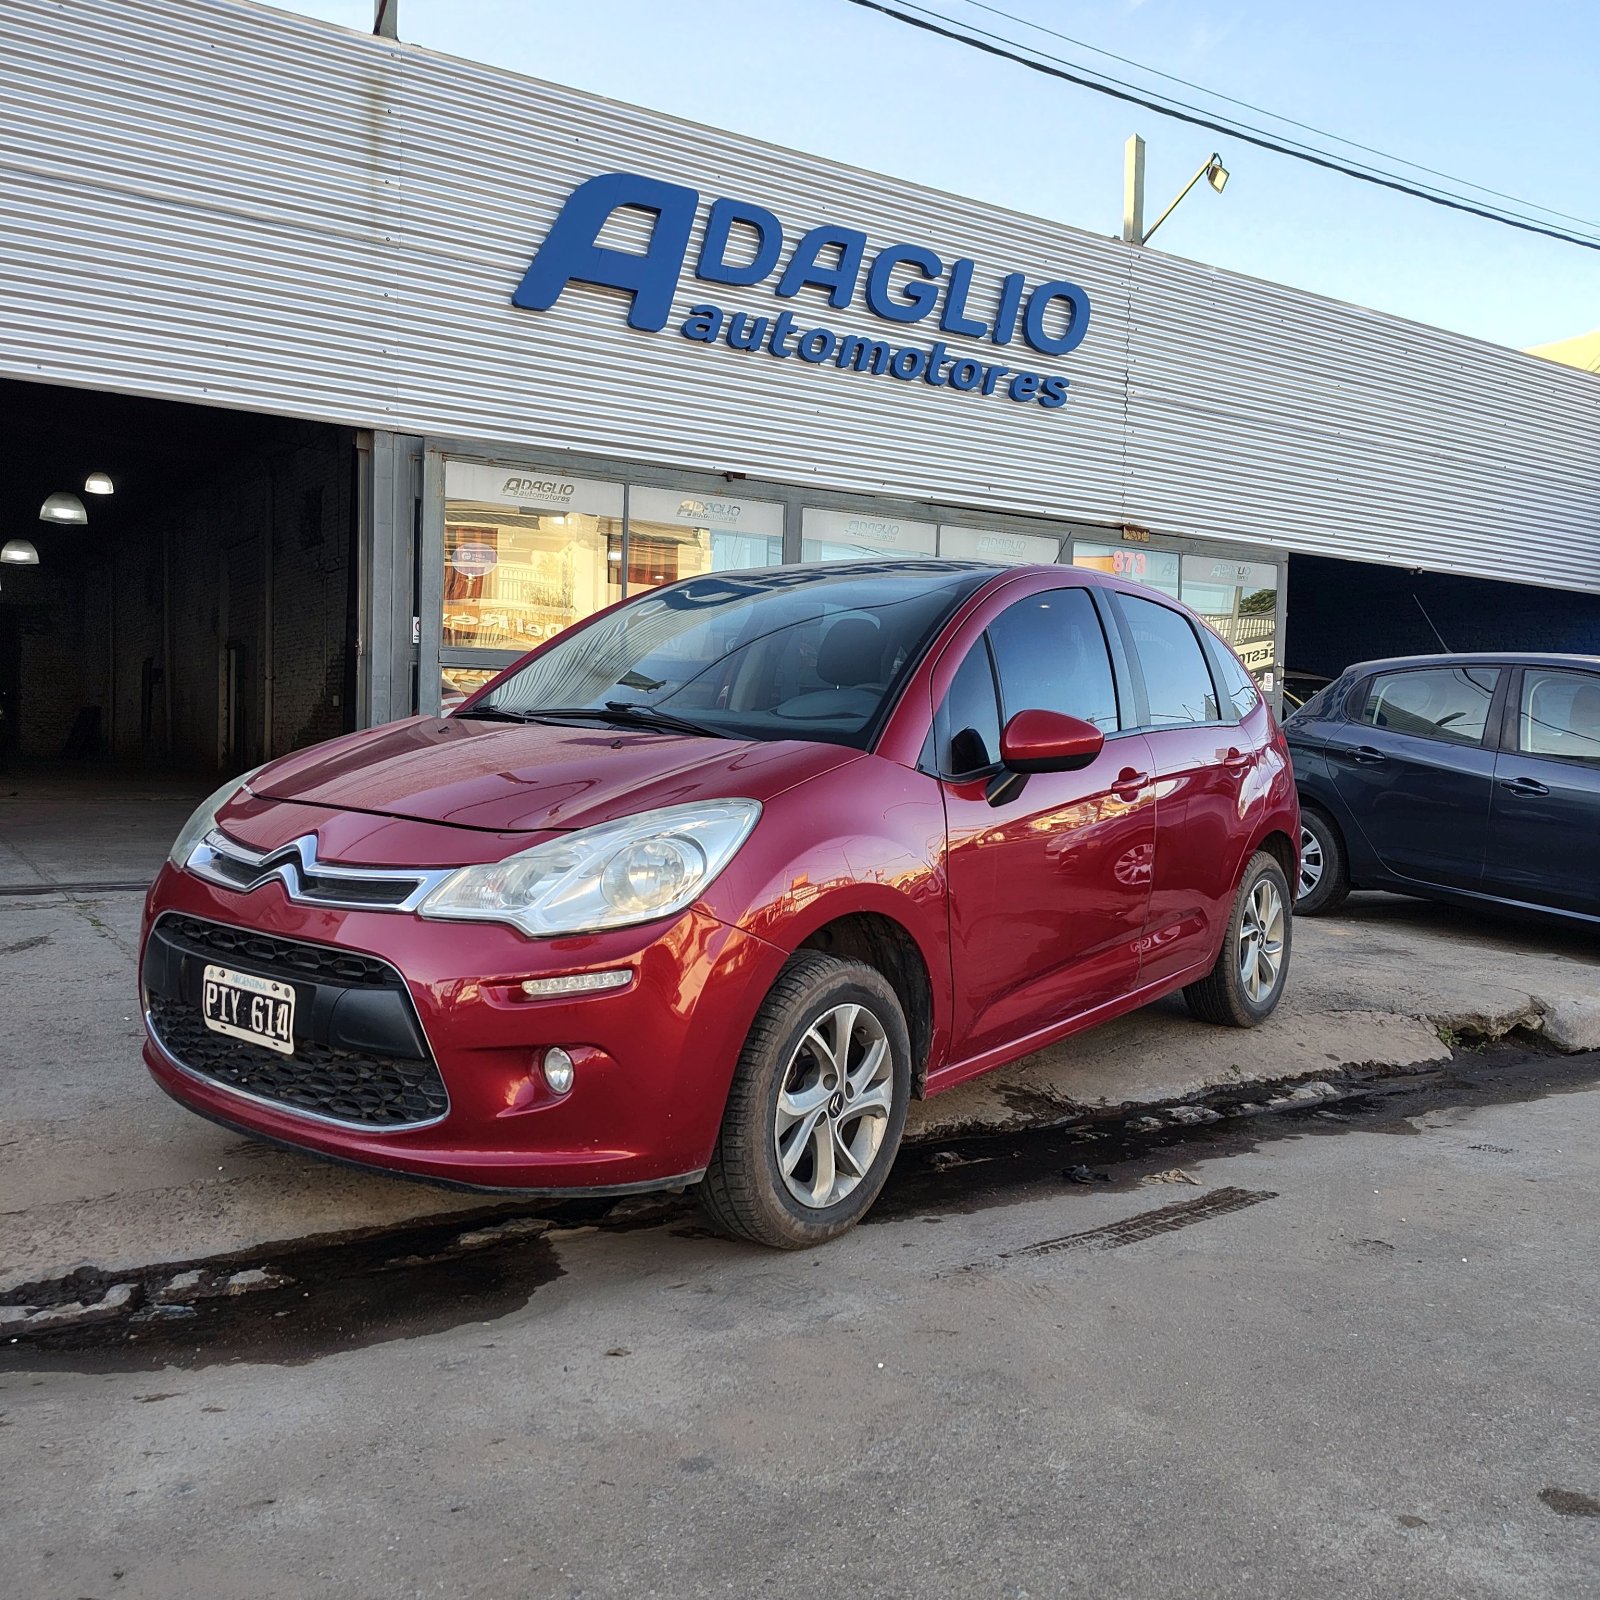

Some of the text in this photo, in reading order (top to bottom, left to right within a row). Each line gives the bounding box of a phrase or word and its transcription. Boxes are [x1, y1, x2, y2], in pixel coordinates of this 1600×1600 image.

[511, 172, 1091, 356] ADAGLIO
[681, 304, 1070, 408] automotores
[502, 477, 575, 496] ADAGLIO
[518, 490, 571, 502] automotores
[1112, 550, 1146, 575] 873
[206, 982, 290, 1041] PIY 614
